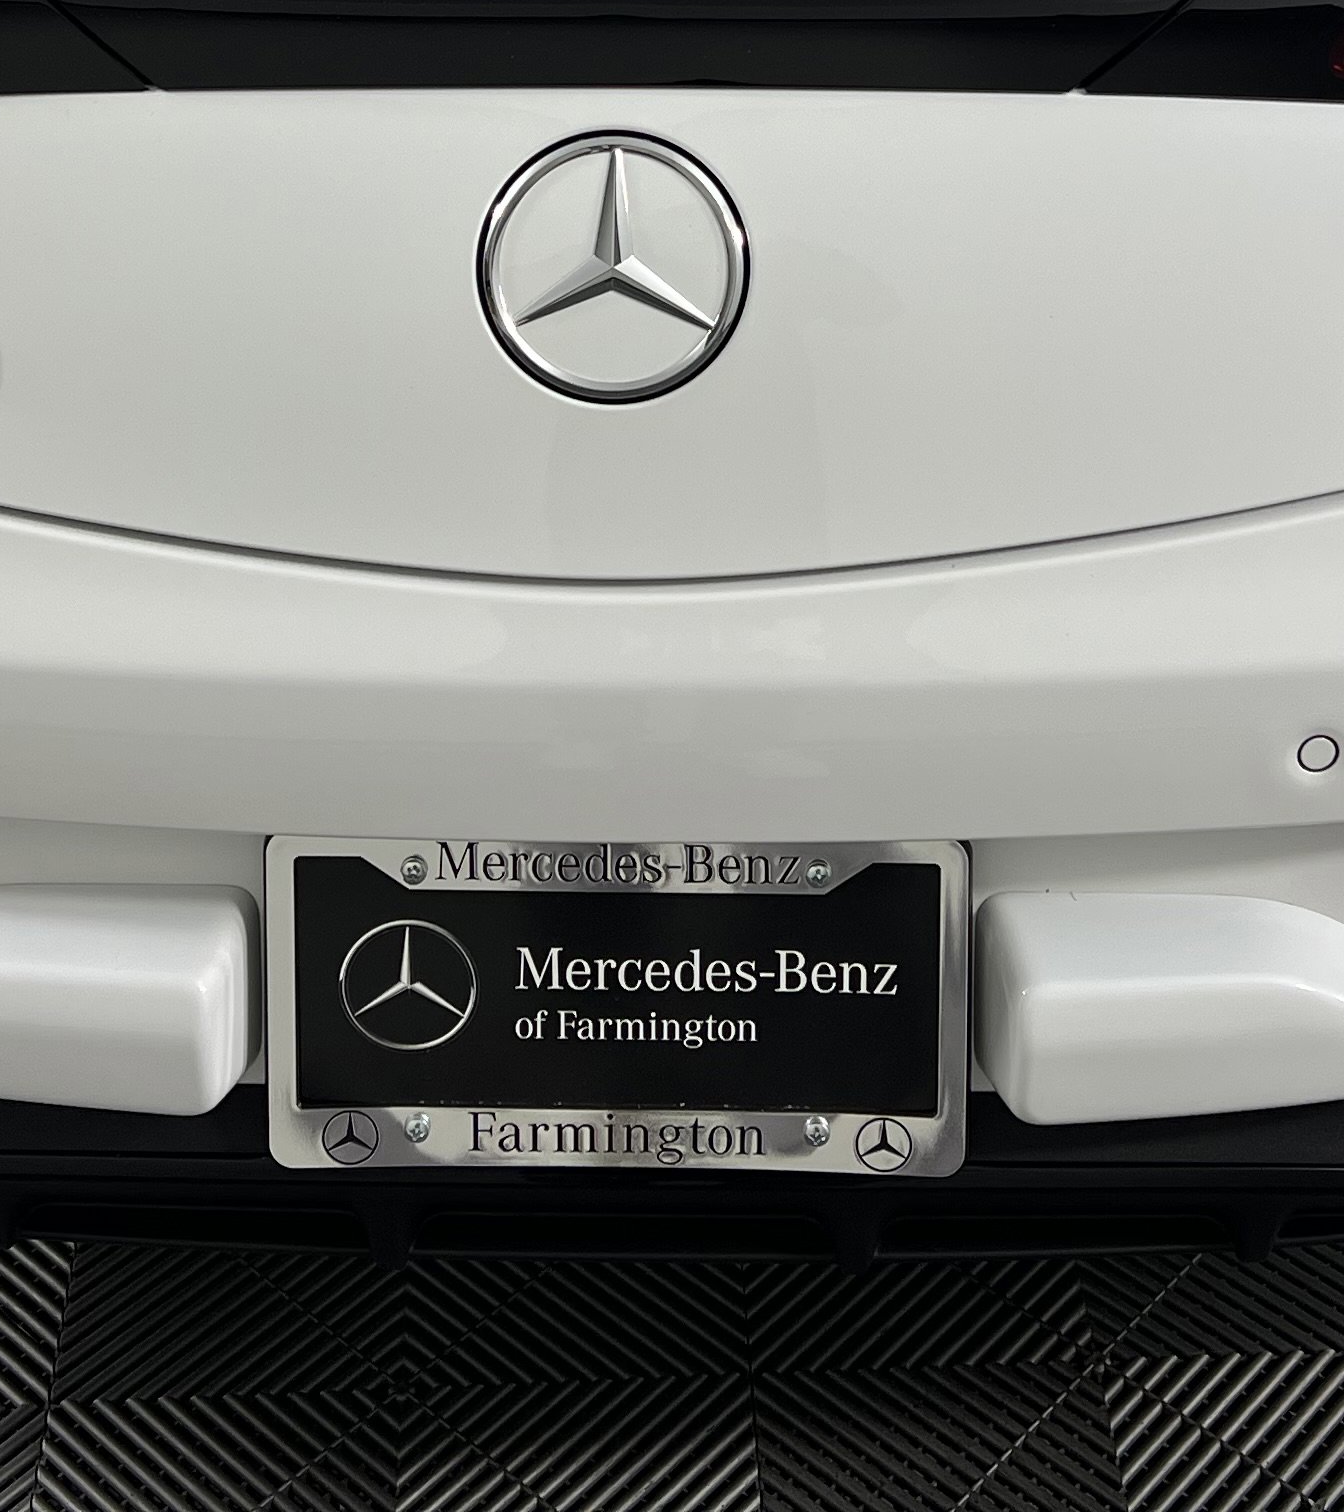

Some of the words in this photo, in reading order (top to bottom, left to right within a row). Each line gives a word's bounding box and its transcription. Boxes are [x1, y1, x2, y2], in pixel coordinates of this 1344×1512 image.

[435, 841, 801, 886] Mercedes-Benz
[514, 946, 899, 996] Mercedes-Benz
[514, 1010, 549, 1041] of
[557, 1010, 758, 1049] Farmington
[467, 1112, 767, 1165] Farmington
